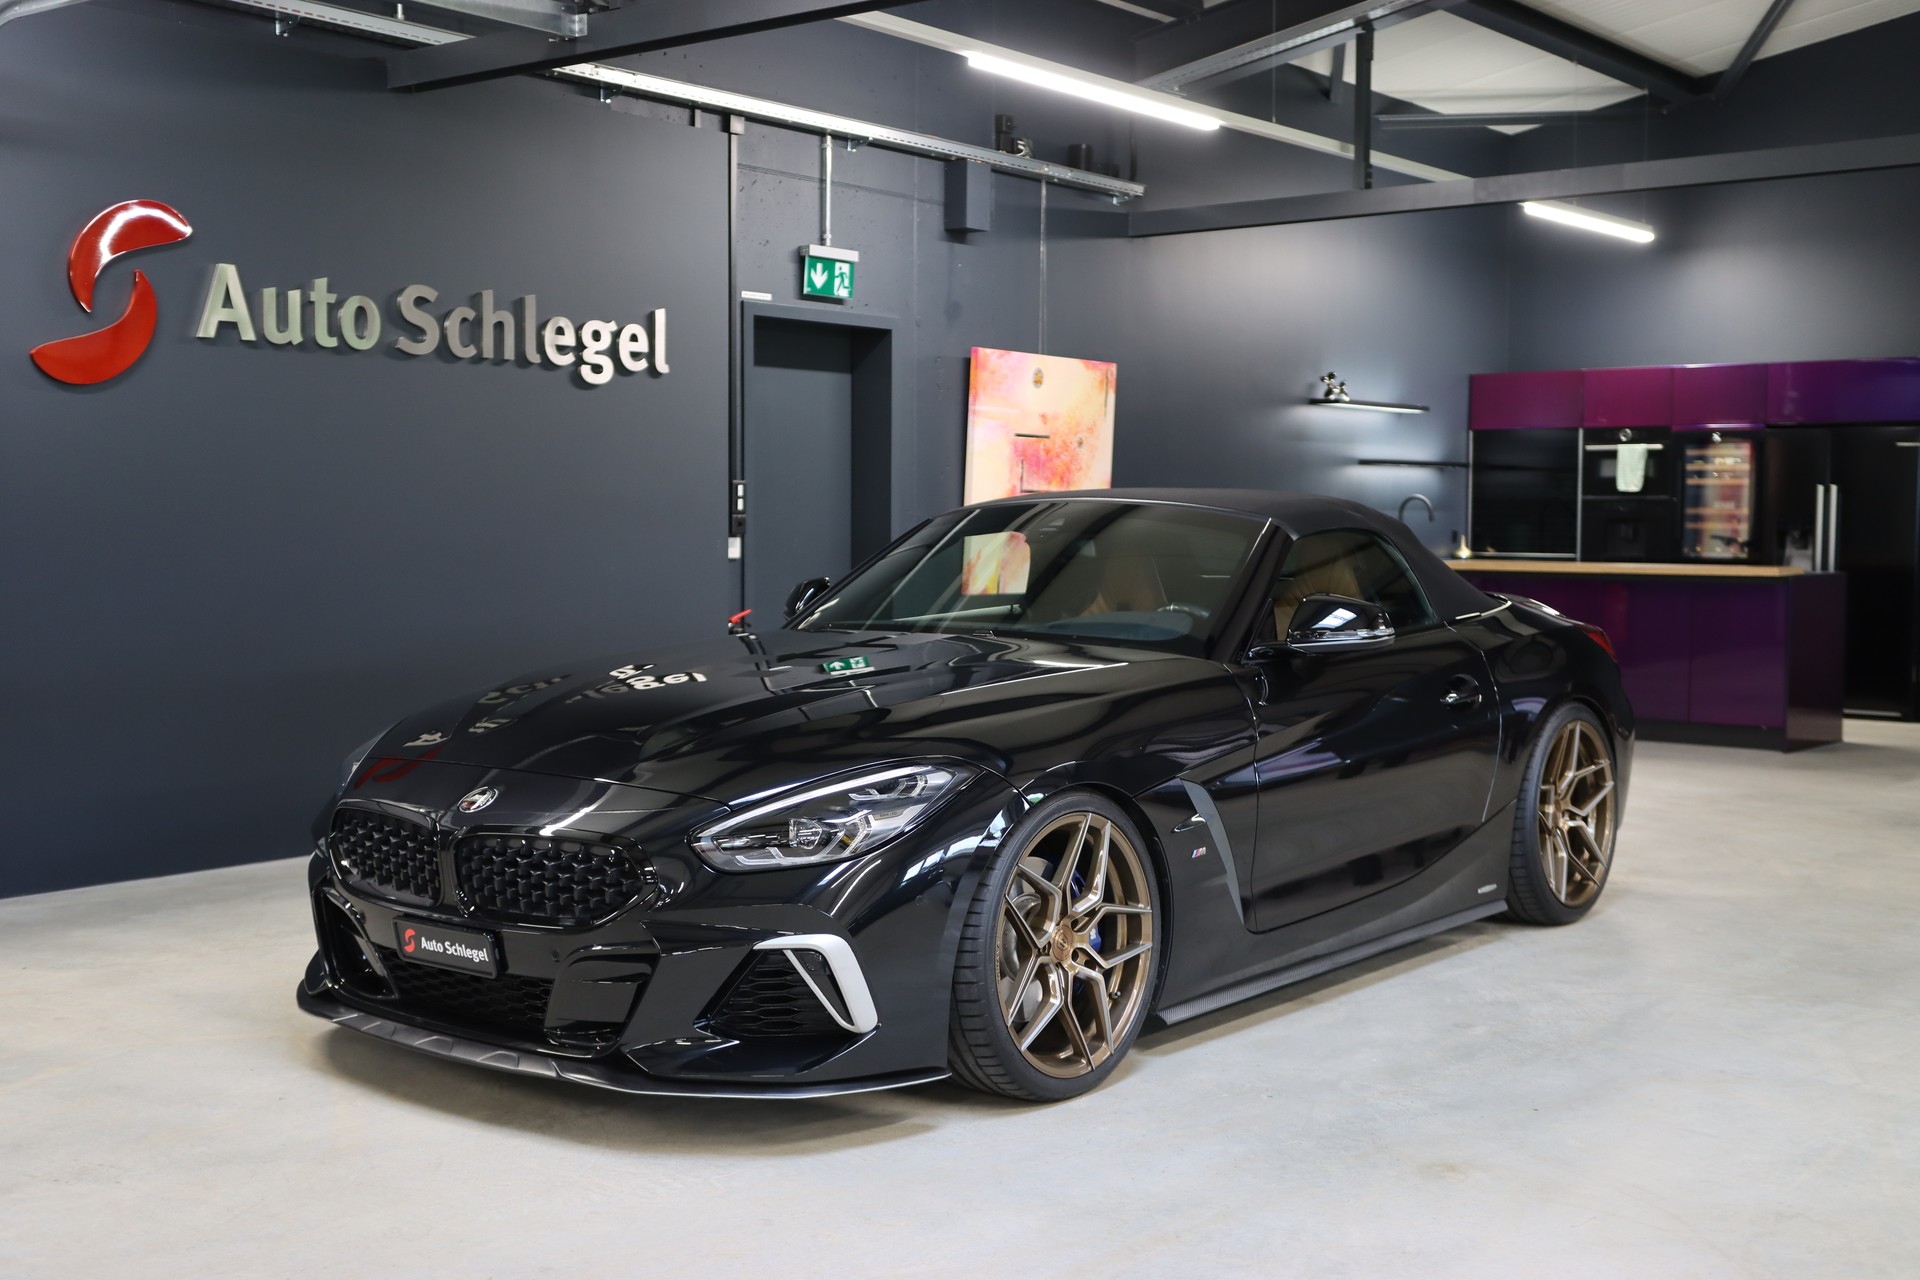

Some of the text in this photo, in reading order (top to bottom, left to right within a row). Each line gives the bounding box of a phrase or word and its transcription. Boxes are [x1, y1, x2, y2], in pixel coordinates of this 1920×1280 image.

[196, 263, 669, 385] Auto Schlegel
[421, 937, 489, 963] Auto Schlegel
